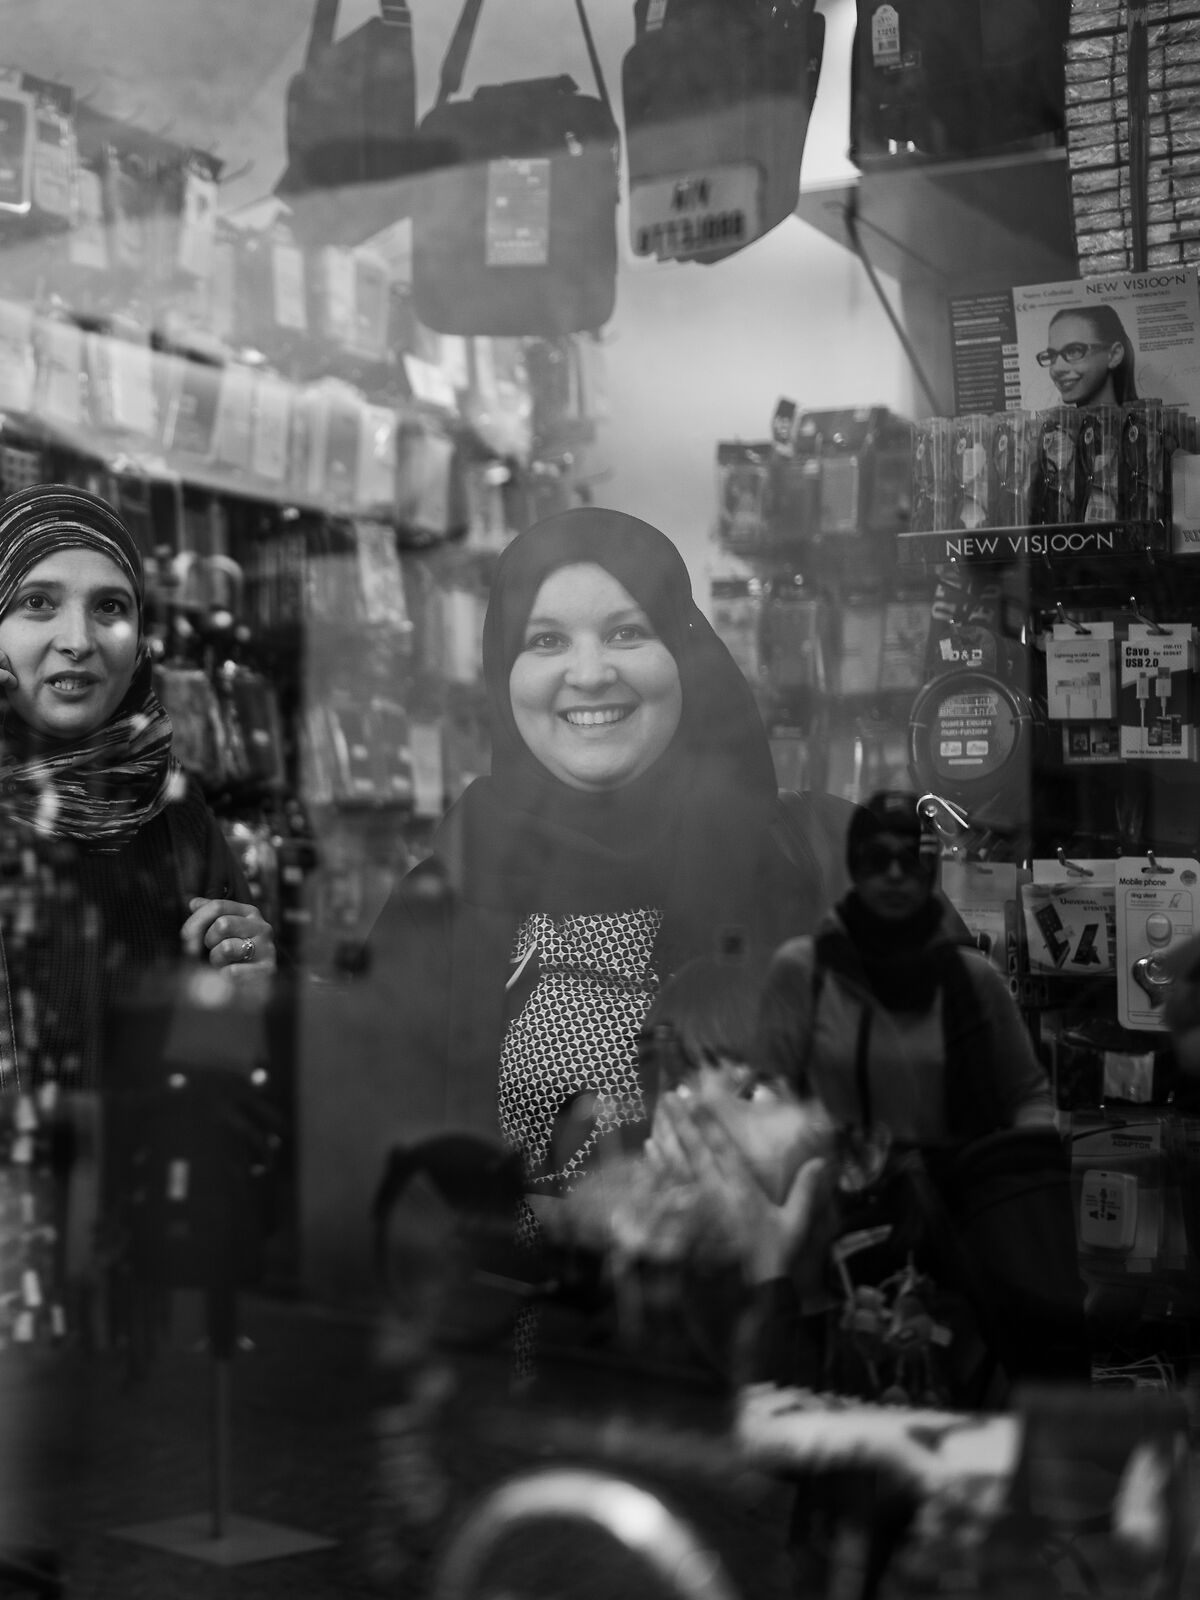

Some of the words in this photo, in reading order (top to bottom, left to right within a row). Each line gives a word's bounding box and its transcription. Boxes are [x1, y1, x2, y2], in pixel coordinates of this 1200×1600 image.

[1086, 281, 1118, 296] NEW
[946, 536, 999, 557] NEW
[1125, 646, 1150, 657] Cavo
[1125, 657, 1143, 669] USB
[1144, 657, 1159, 669] 2.0
[1119, 877, 1143, 886] Mobile
[1143, 878, 1167, 887] phone
